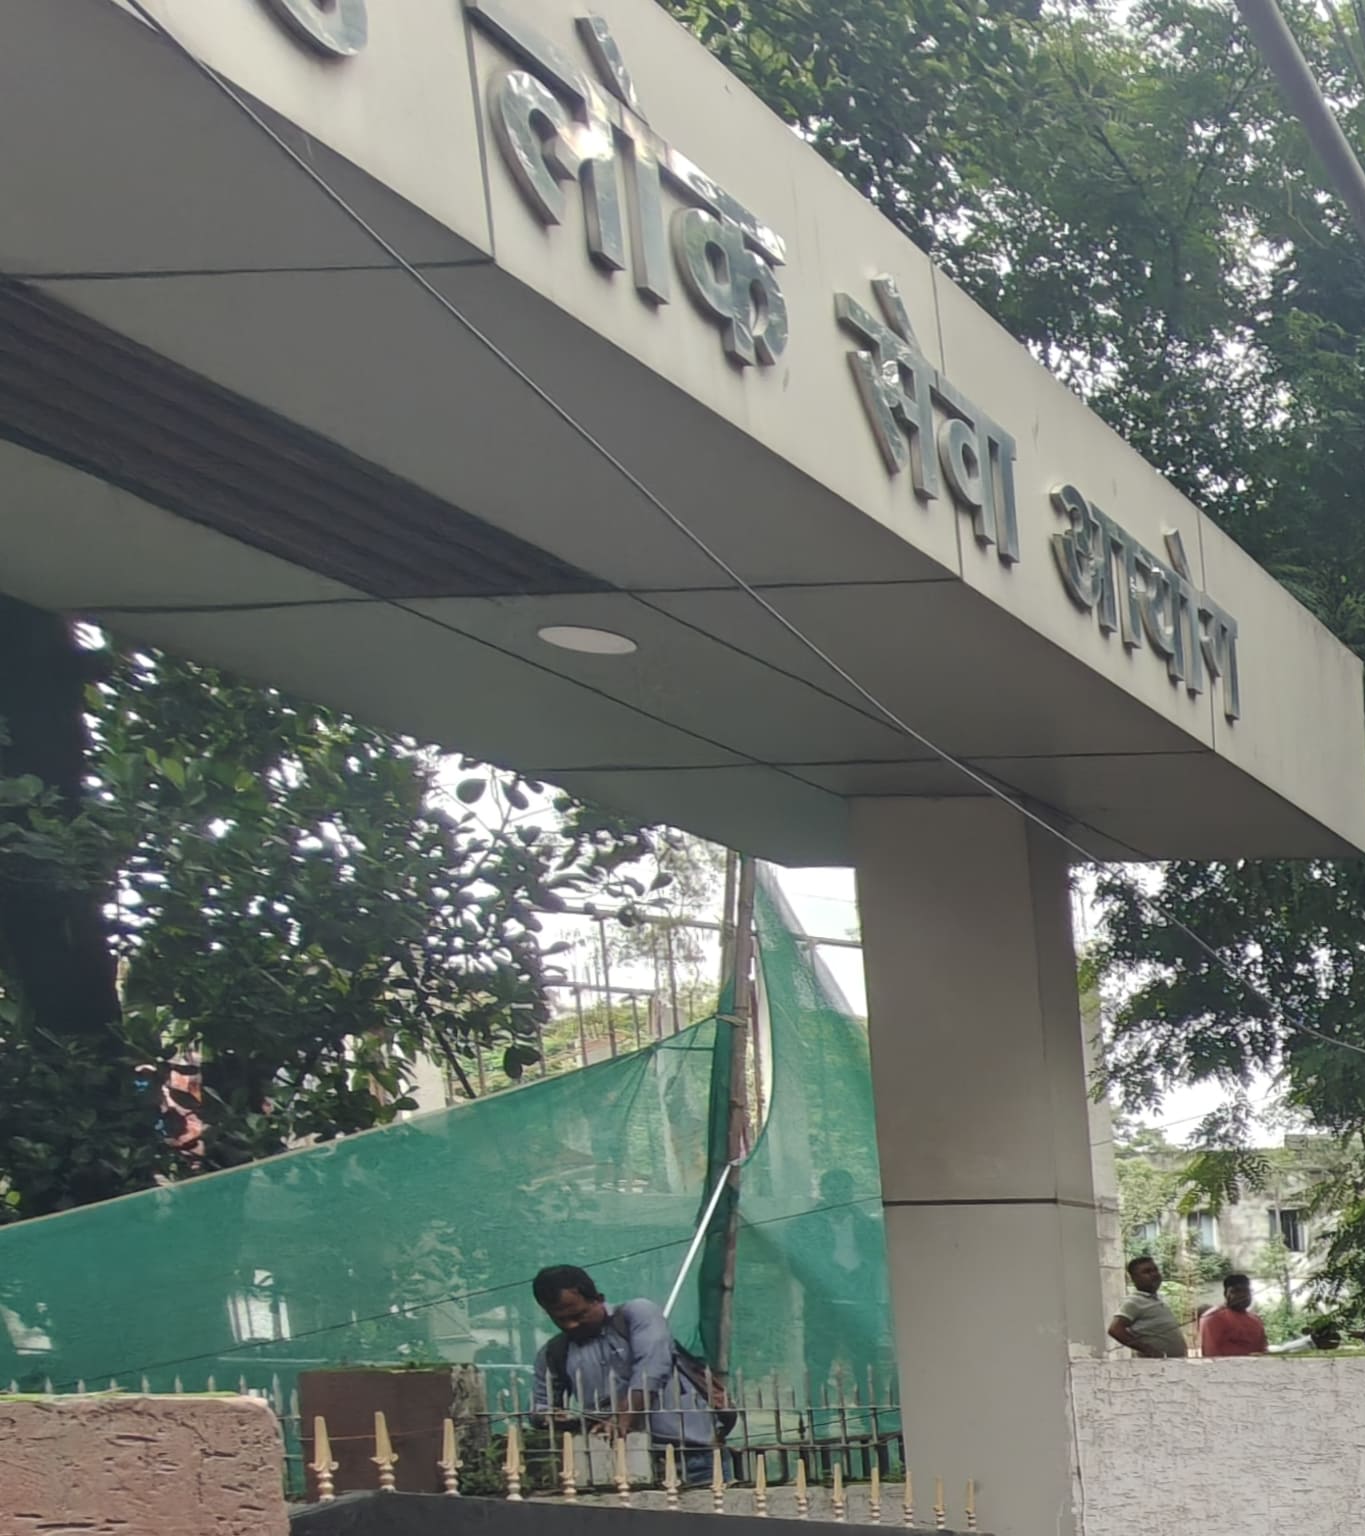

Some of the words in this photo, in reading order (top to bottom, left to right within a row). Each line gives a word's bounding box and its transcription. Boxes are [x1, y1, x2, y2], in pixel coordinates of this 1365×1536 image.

[466, 2, 790, 370] लोक
[834, 273, 1019, 565] सेवा
[1050, 483, 1241, 722] आयोग
